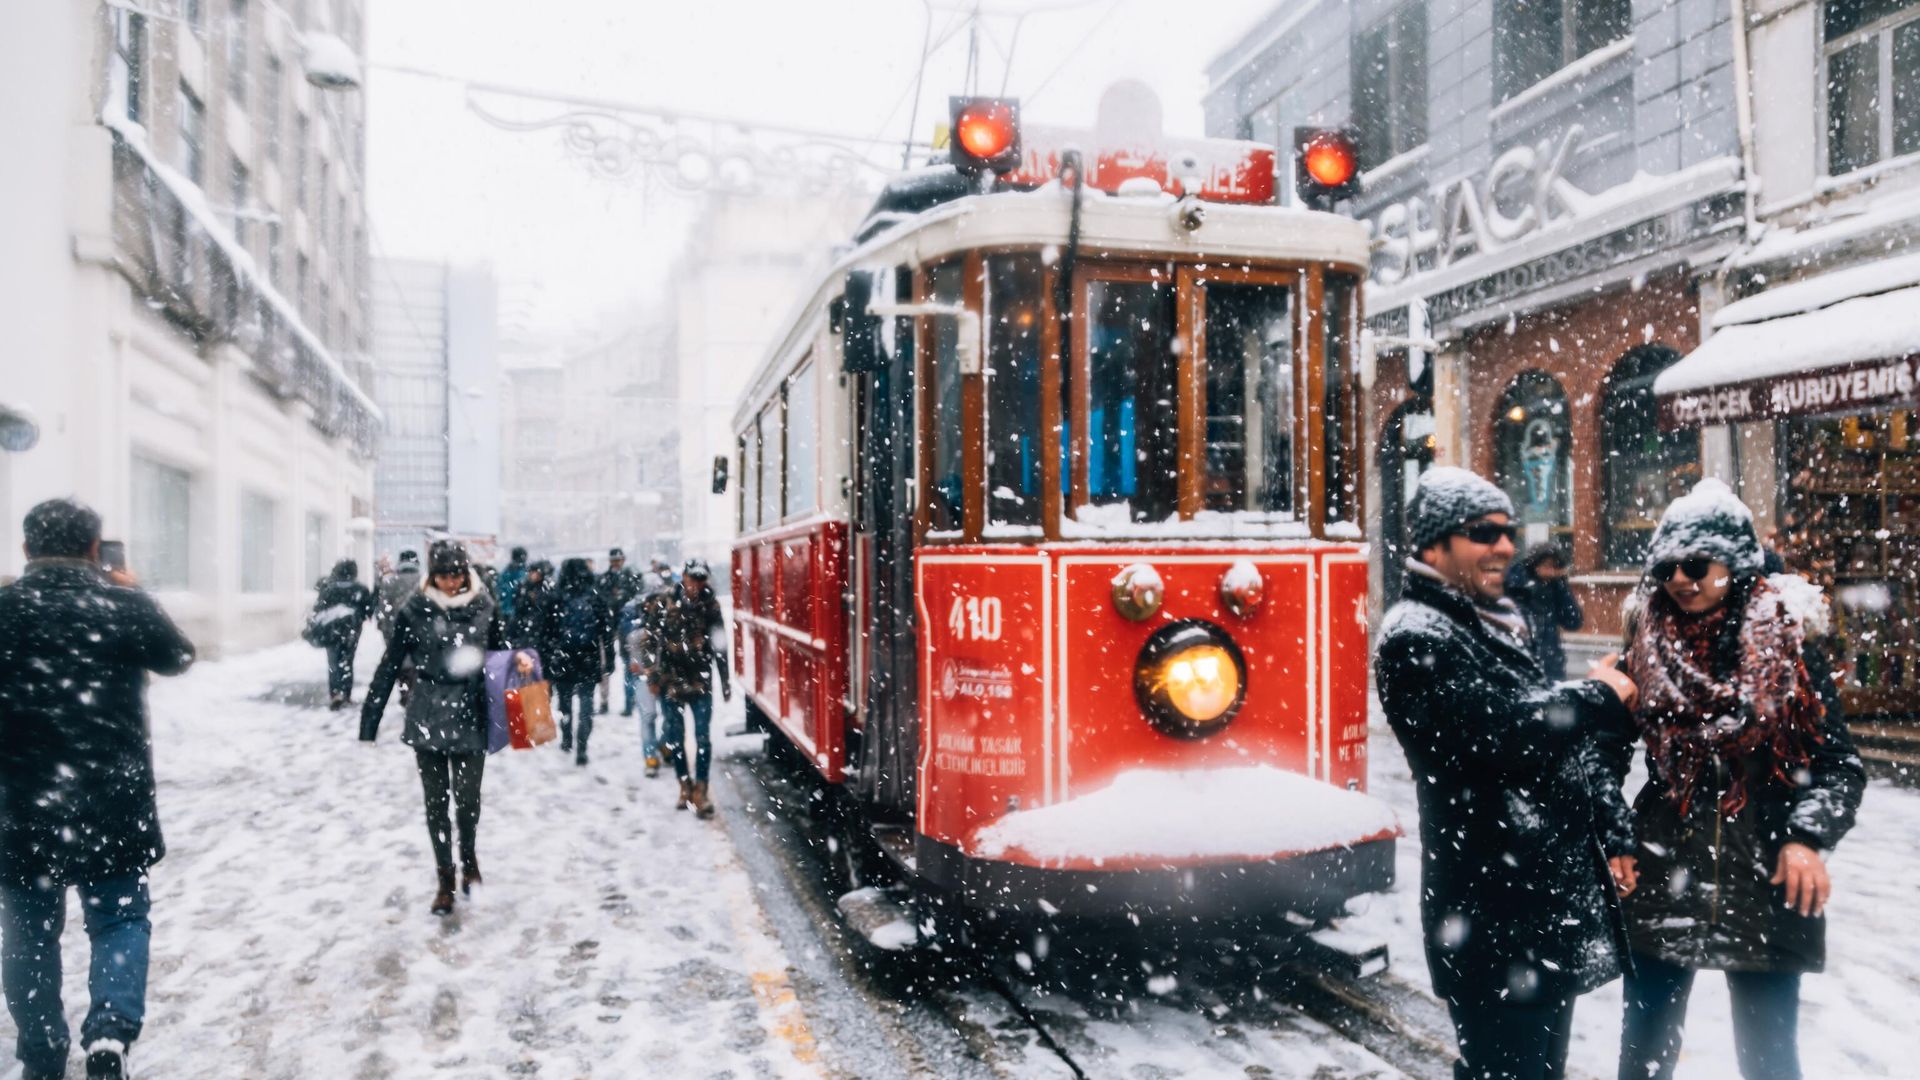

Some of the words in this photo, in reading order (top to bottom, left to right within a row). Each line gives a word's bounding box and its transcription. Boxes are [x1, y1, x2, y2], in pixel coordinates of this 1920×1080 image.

[1374, 124, 1588, 280] SHACK
[948, 595, 1002, 641] 410
[980, 735, 1022, 754] YASAK
